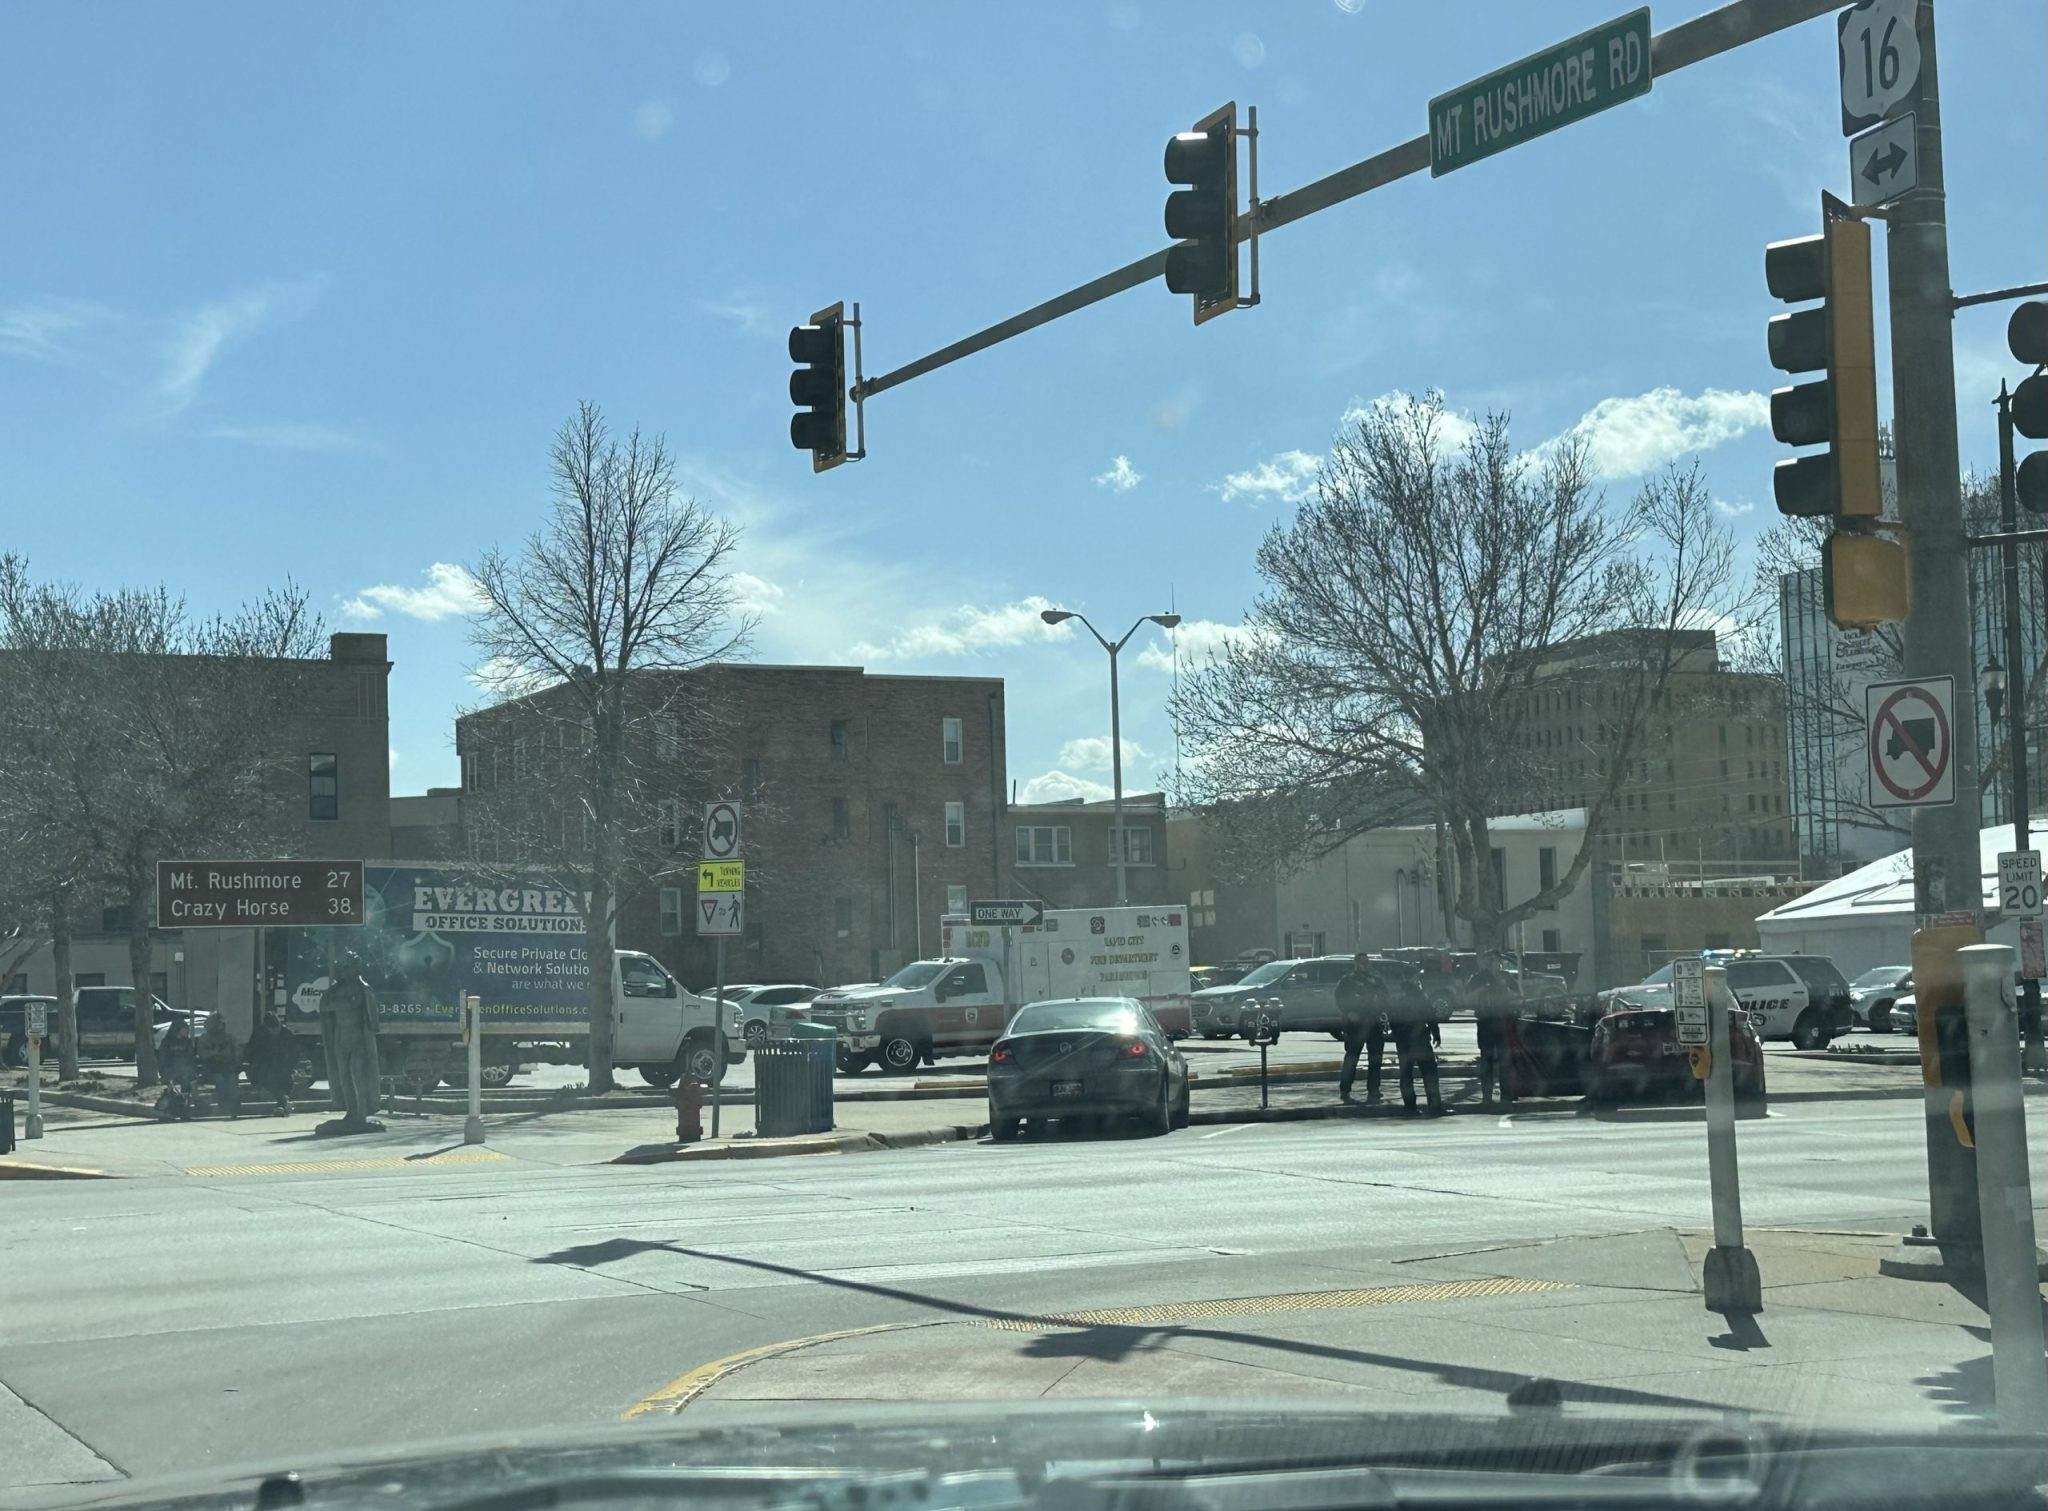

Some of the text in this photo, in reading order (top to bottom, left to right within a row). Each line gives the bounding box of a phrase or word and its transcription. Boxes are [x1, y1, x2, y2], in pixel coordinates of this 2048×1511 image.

[1861, 16, 1900, 98] 16
[1437, 31, 1641, 160] MT RUSHMORE RD
[2001, 857, 2037, 869] SPEED
[171, 871, 351, 889] Mt. Rushmore 27
[2006, 871, 2033, 883] LIMIT
[2005, 885, 2037, 909] 20
[171, 897, 351, 920] Crazy Horse 38
[977, 908, 1021, 919] ONE WAY
[425, 915, 489, 930] OFFICE
[473, 946, 518, 959] Secure
[521, 948, 567, 960] Private
[473, 961, 590, 976] & Network Solutio
[511, 979, 531, 990] are
[533, 979, 563, 990] what
[566, 980, 584, 990] we
[1738, 999, 1790, 1011] OLICE
